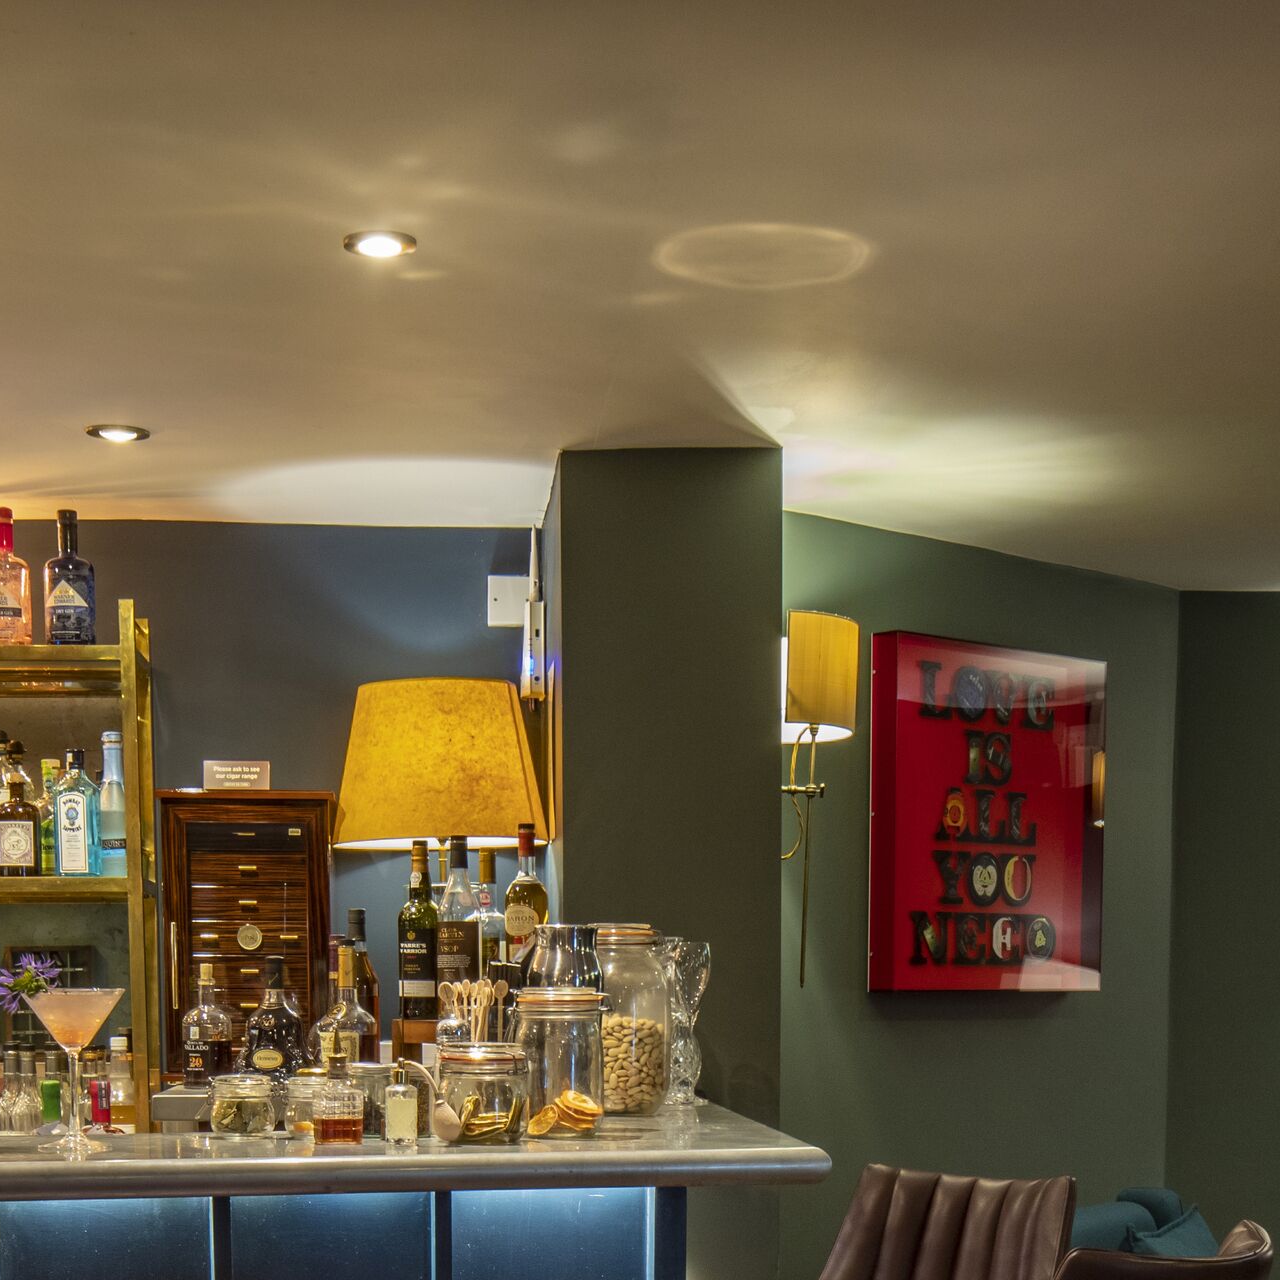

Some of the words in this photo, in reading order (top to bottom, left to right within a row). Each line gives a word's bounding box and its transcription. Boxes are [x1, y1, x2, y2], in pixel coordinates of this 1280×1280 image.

[917, 661, 1056, 731] LOVE
[964, 730, 1012, 785] IS
[62, 798, 81, 806] BOMBAY
[936, 787, 1037, 846] ALL
[932, 849, 1037, 908] YOU
[439, 945, 459, 953] VSOP
[909, 910, 1057, 966] NEED
[189, 1057, 203, 1068] 20
